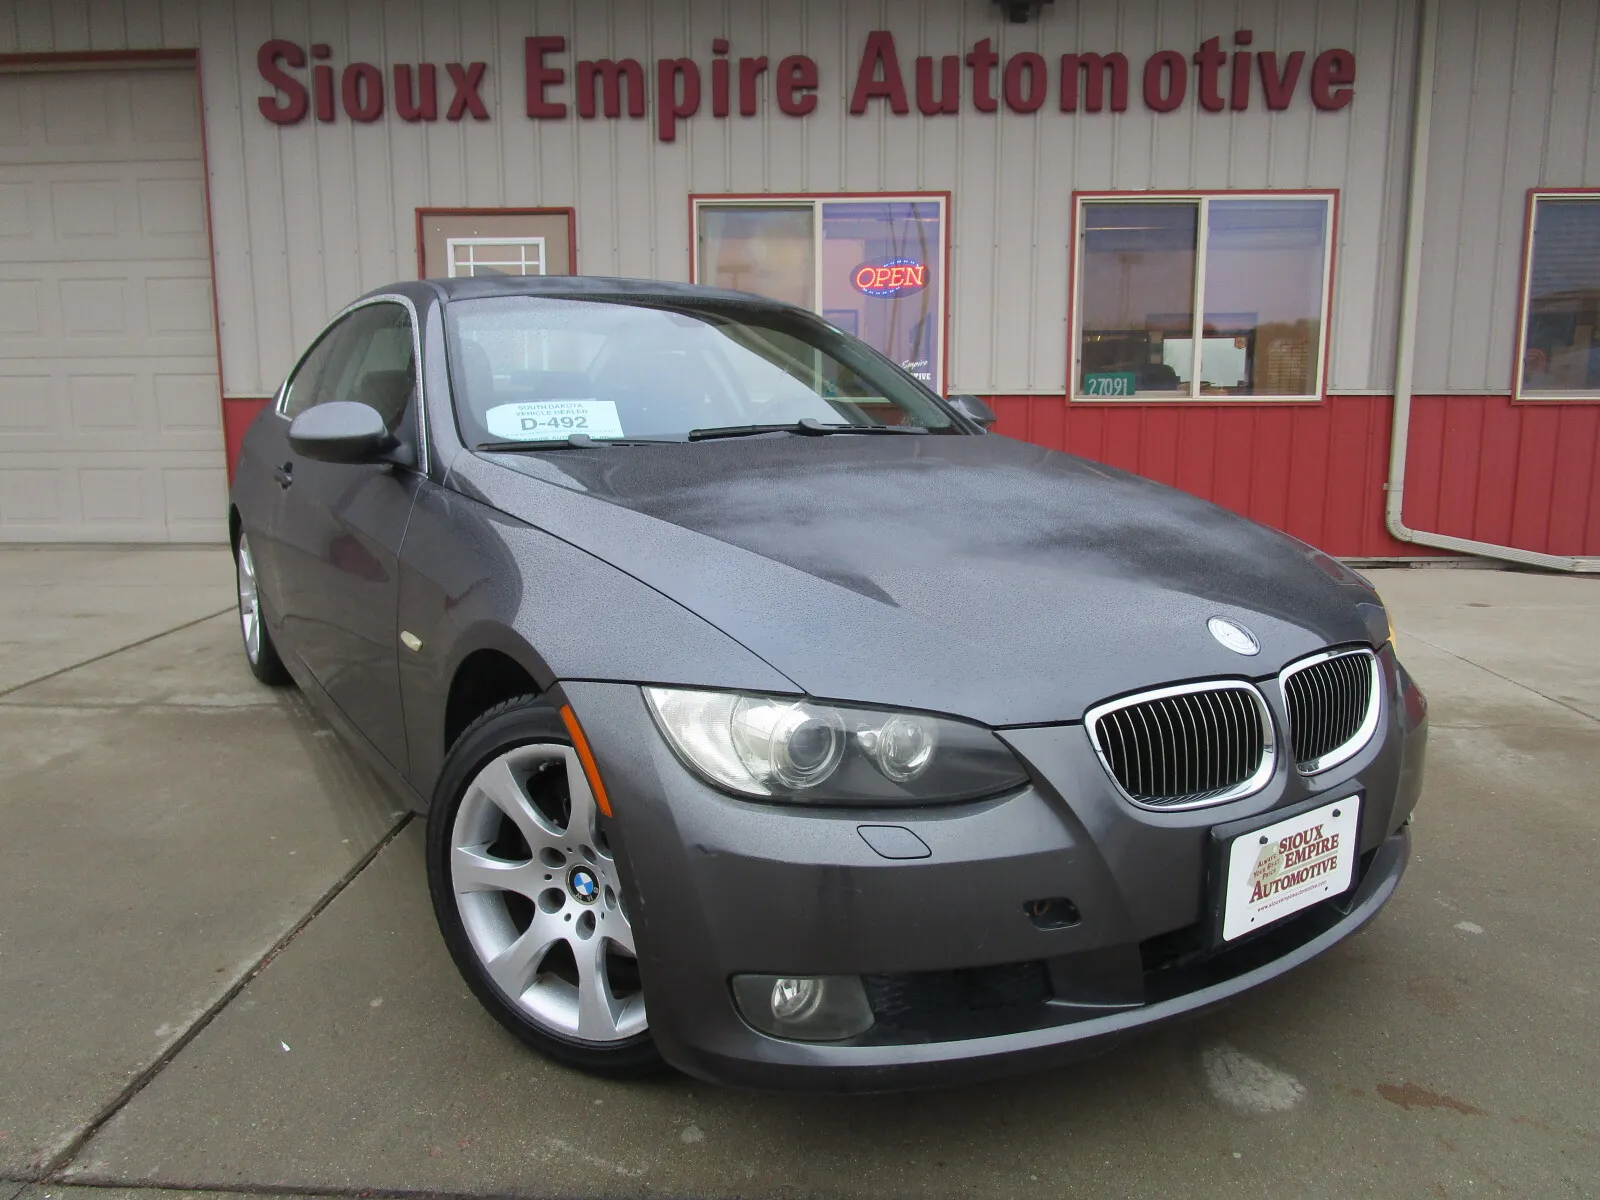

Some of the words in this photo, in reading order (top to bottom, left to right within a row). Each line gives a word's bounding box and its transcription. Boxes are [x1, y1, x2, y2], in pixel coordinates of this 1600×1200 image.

[257, 39, 490, 126] Sioux
[525, 36, 818, 142] Empire
[850, 30, 1356, 117] Automotive
[856, 266, 925, 288] OPEN
[1088, 378, 1128, 396] 27091
[521, 416, 589, 431] D-492
[1279, 823, 1324, 854] SIOUX
[1284, 833, 1339, 868] EMPIRE
[1248, 856, 1337, 904] AUTOMOTIVE
